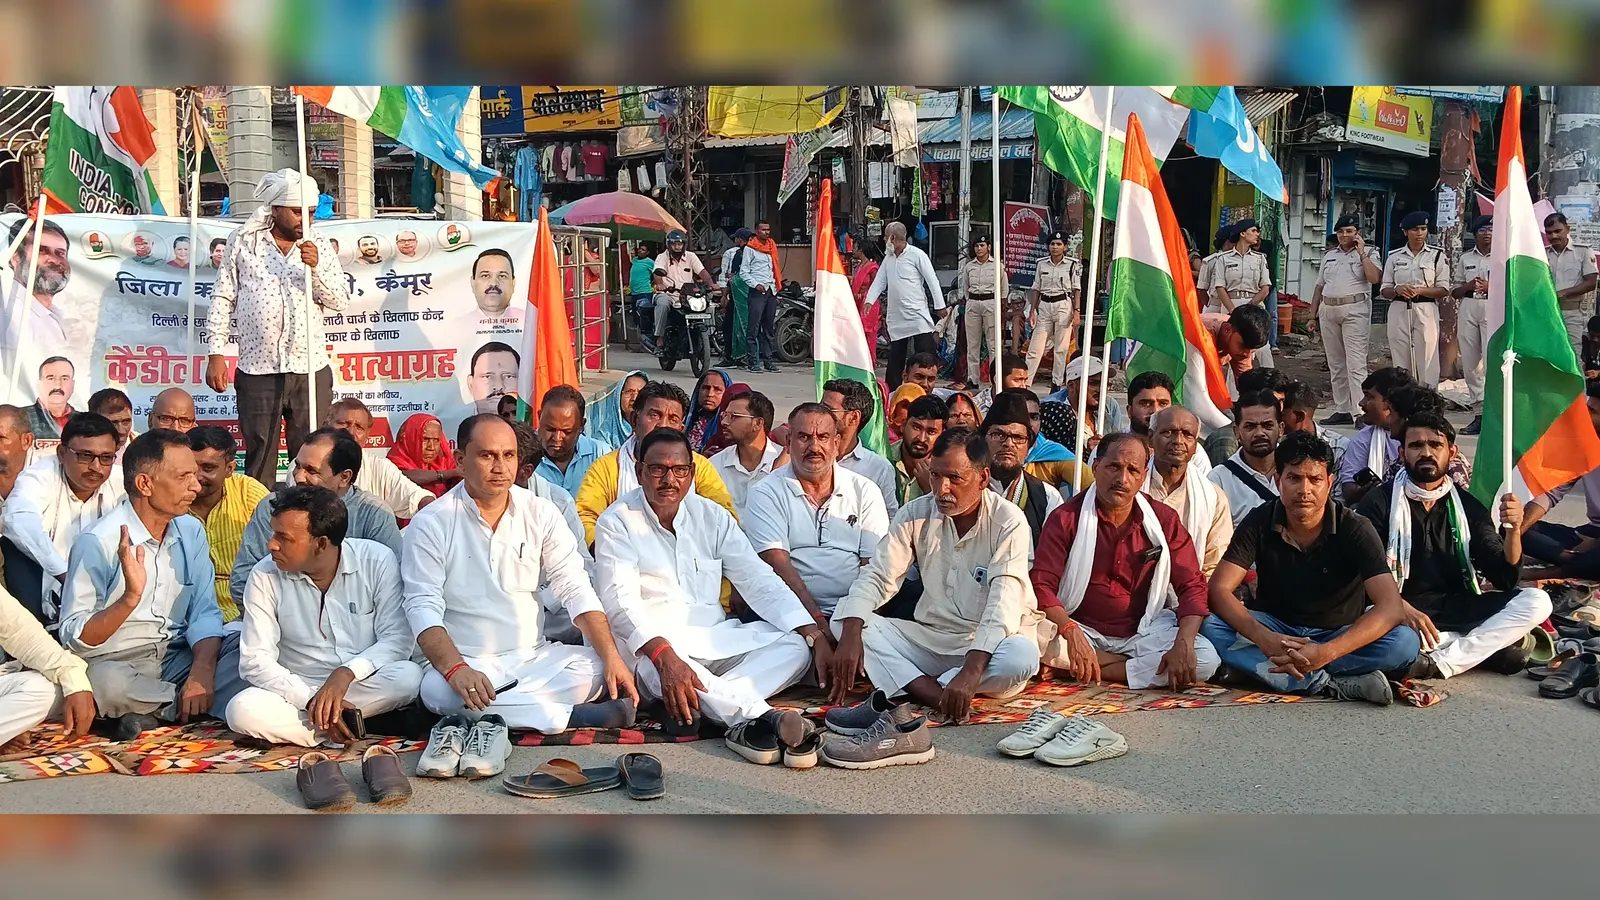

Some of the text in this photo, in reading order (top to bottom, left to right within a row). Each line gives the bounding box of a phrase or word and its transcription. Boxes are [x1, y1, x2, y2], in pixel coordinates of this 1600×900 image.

[1360, 131, 1385, 142] FOOTWEAR
[115, 271, 182, 297] जिला
[375, 269, 433, 296] कैमूर
[152, 313, 179, 327] दिल्ली
[346, 311, 367, 325] चार्ज
[369, 311, 380, 324] के
[383, 310, 419, 323] खिलाफ
[422, 308, 444, 322] केन्द्र
[350, 328, 361, 341] के
[364, 328, 400, 341] खिलाफ
[337, 349, 457, 381] सत्याग्रह
[226, 425, 239, 433] 25
